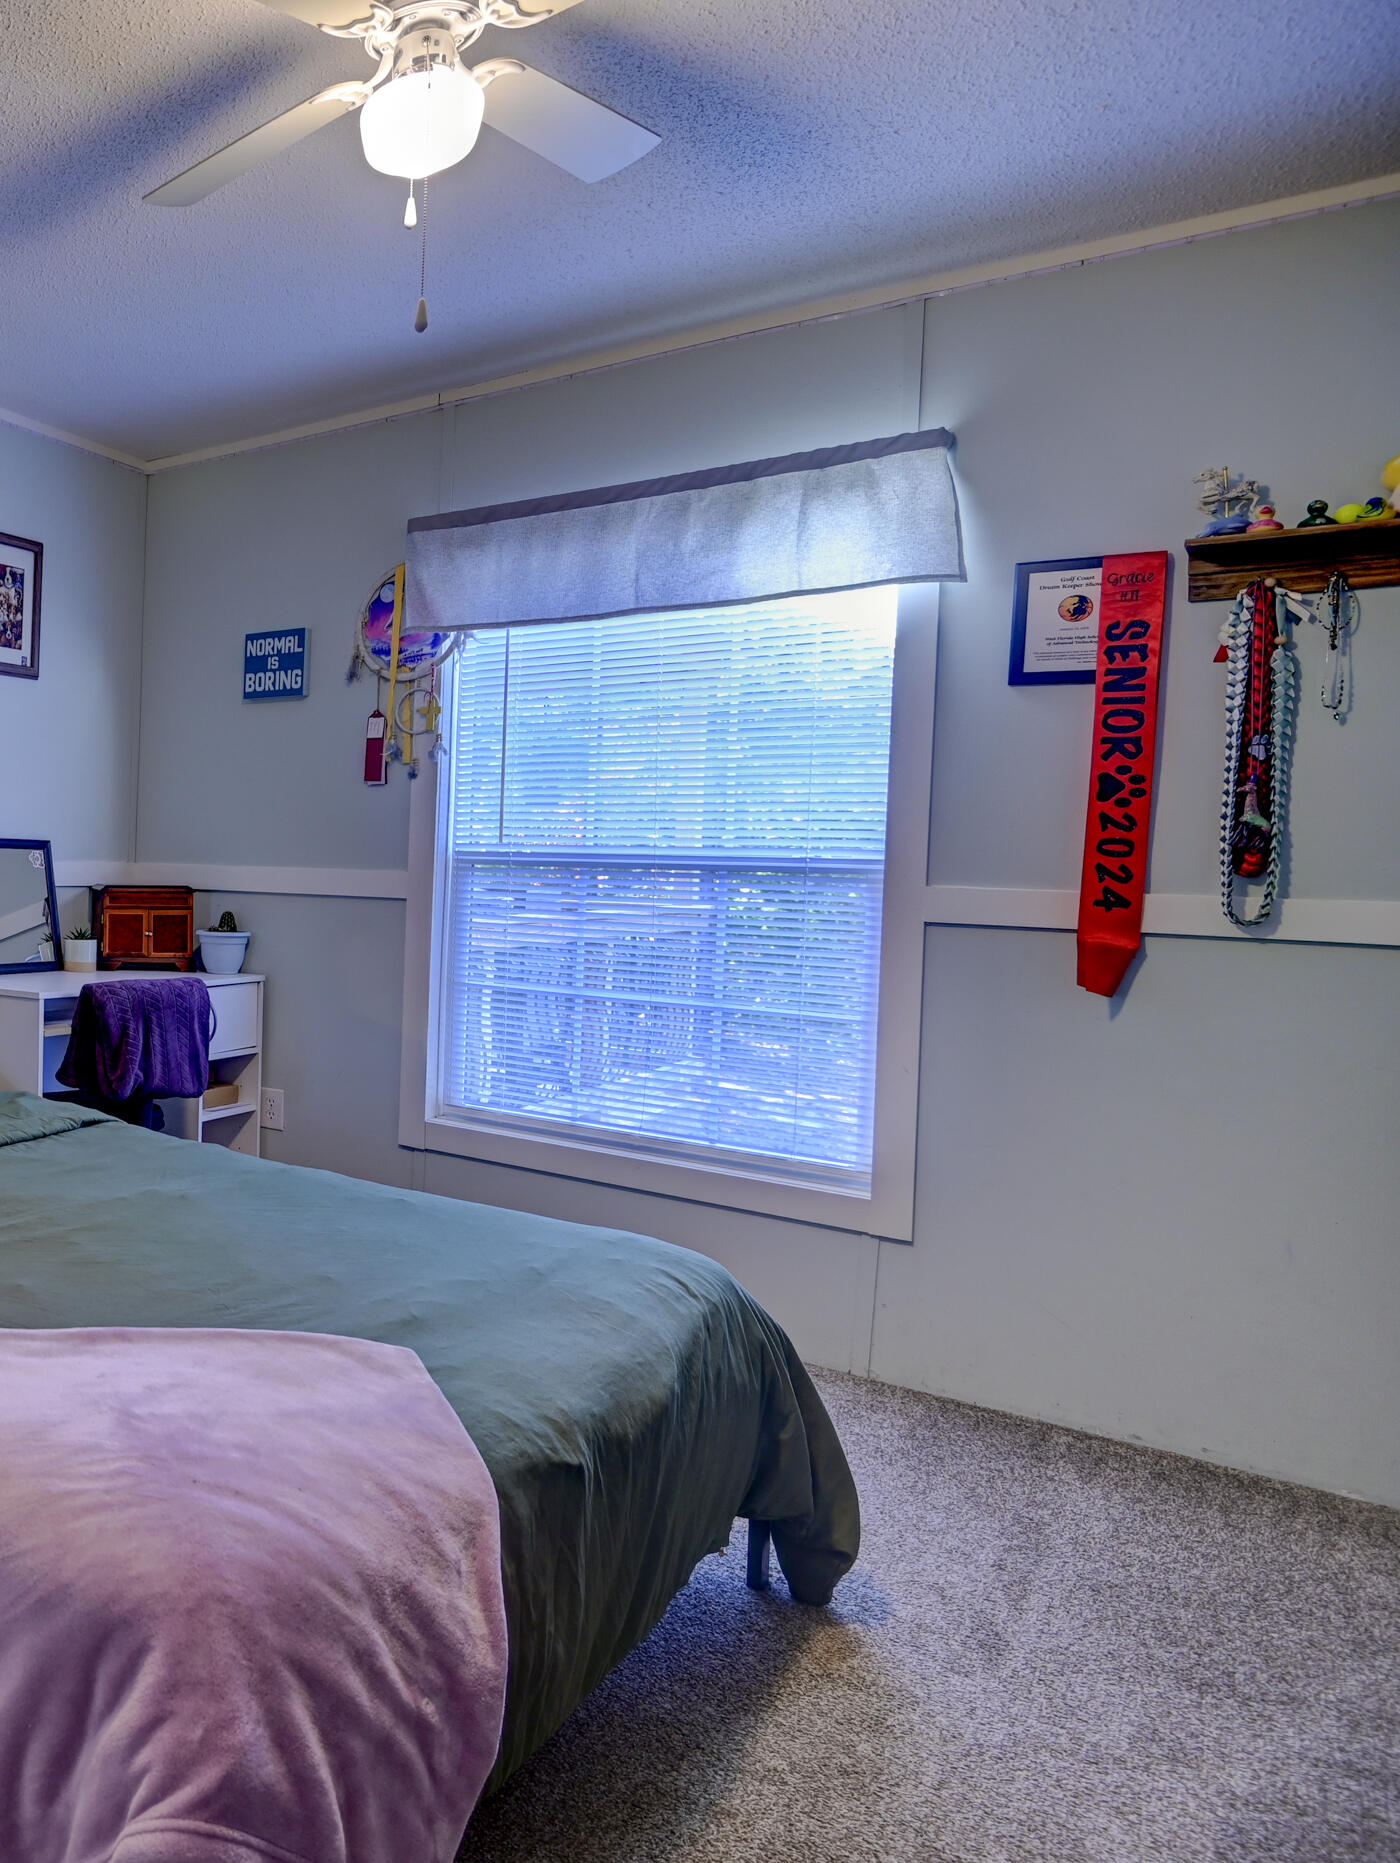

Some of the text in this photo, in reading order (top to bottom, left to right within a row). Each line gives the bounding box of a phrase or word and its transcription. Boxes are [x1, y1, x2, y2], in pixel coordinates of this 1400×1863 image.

[1107, 572, 1155, 586] Gracie
[247, 635, 303, 657] NORMAL
[267, 656, 280, 670] IS
[245, 669, 302, 693] BORING
[1099, 619, 1151, 762] SENIOR
[1093, 811, 1138, 913] 2024
